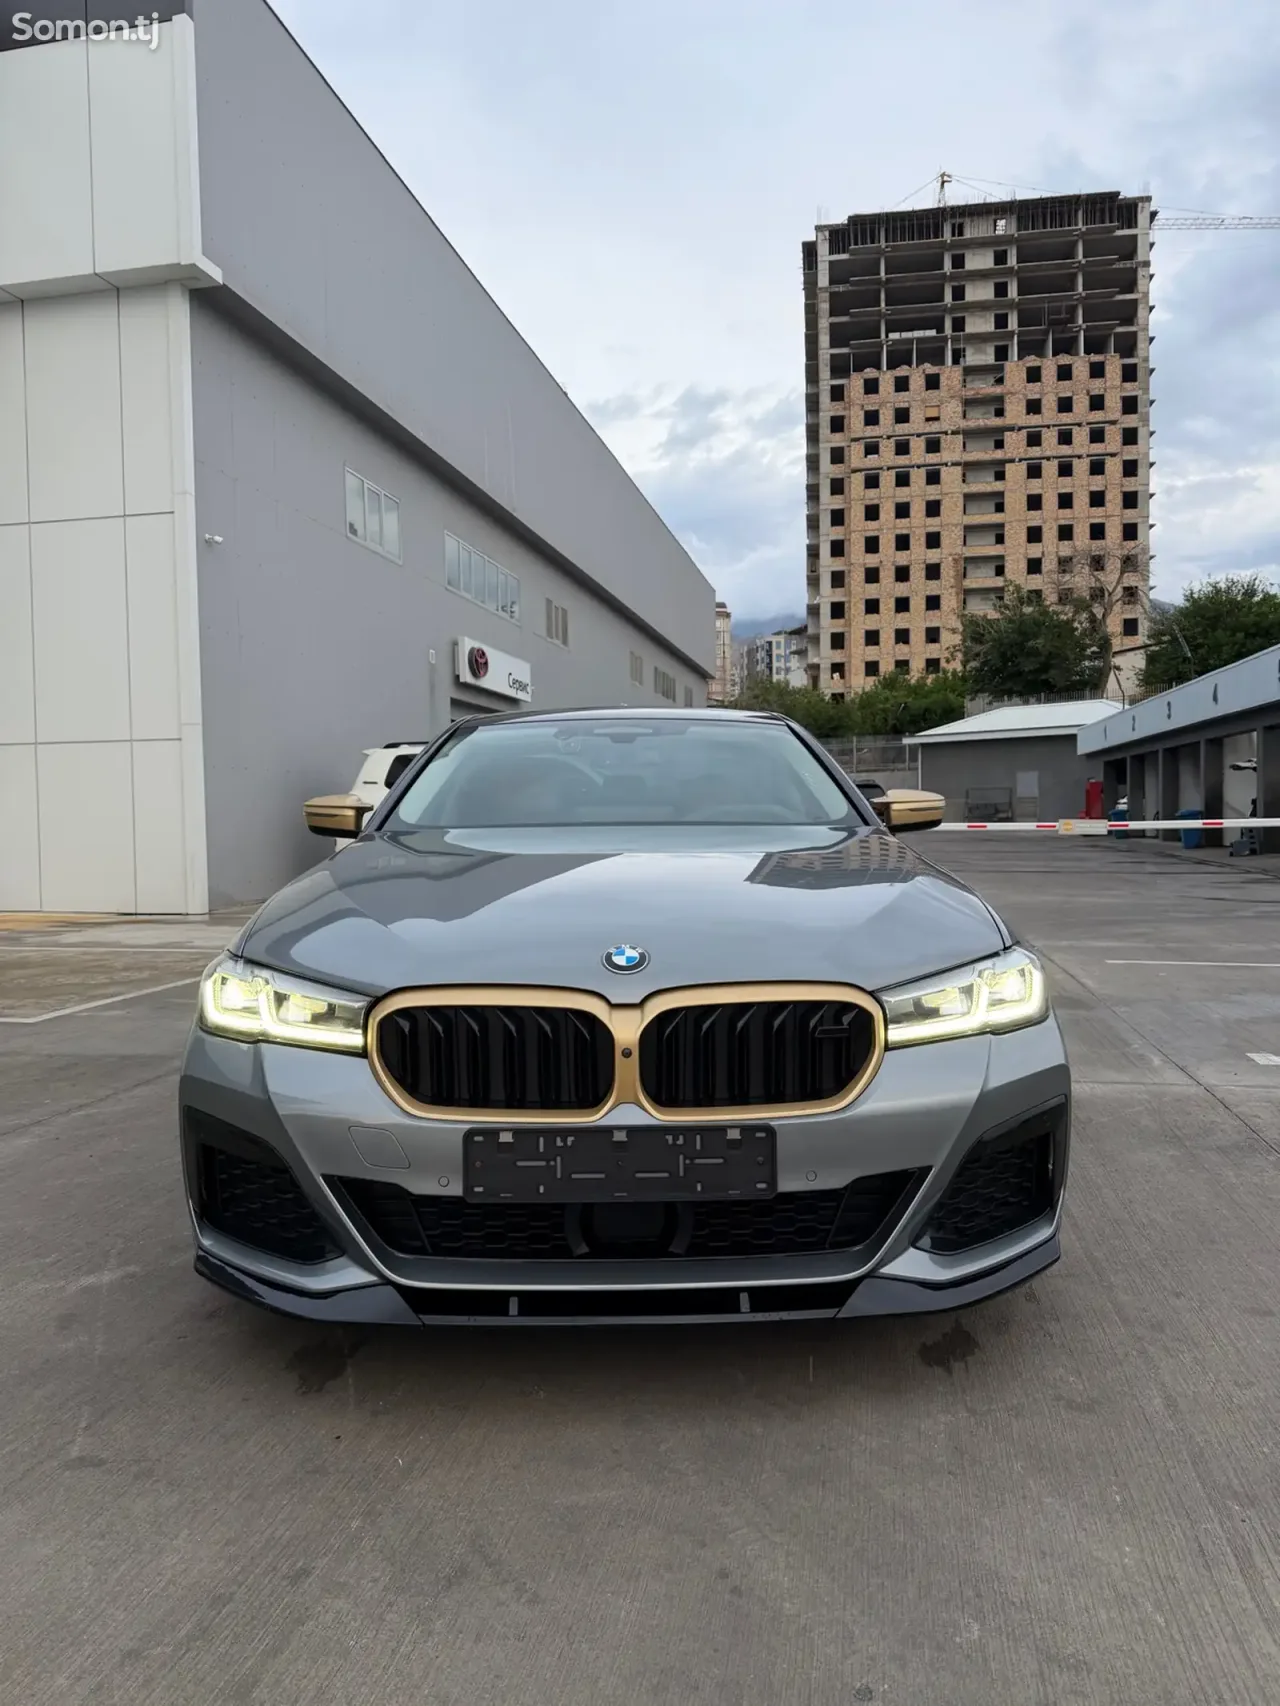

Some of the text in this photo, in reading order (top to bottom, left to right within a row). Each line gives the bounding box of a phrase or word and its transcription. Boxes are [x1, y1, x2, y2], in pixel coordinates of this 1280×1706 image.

[507, 672, 530, 696] Сервис
[1131, 714, 1136, 732] 2
[1166, 700, 1172, 720] 3
[1212, 682, 1219, 706] 4
